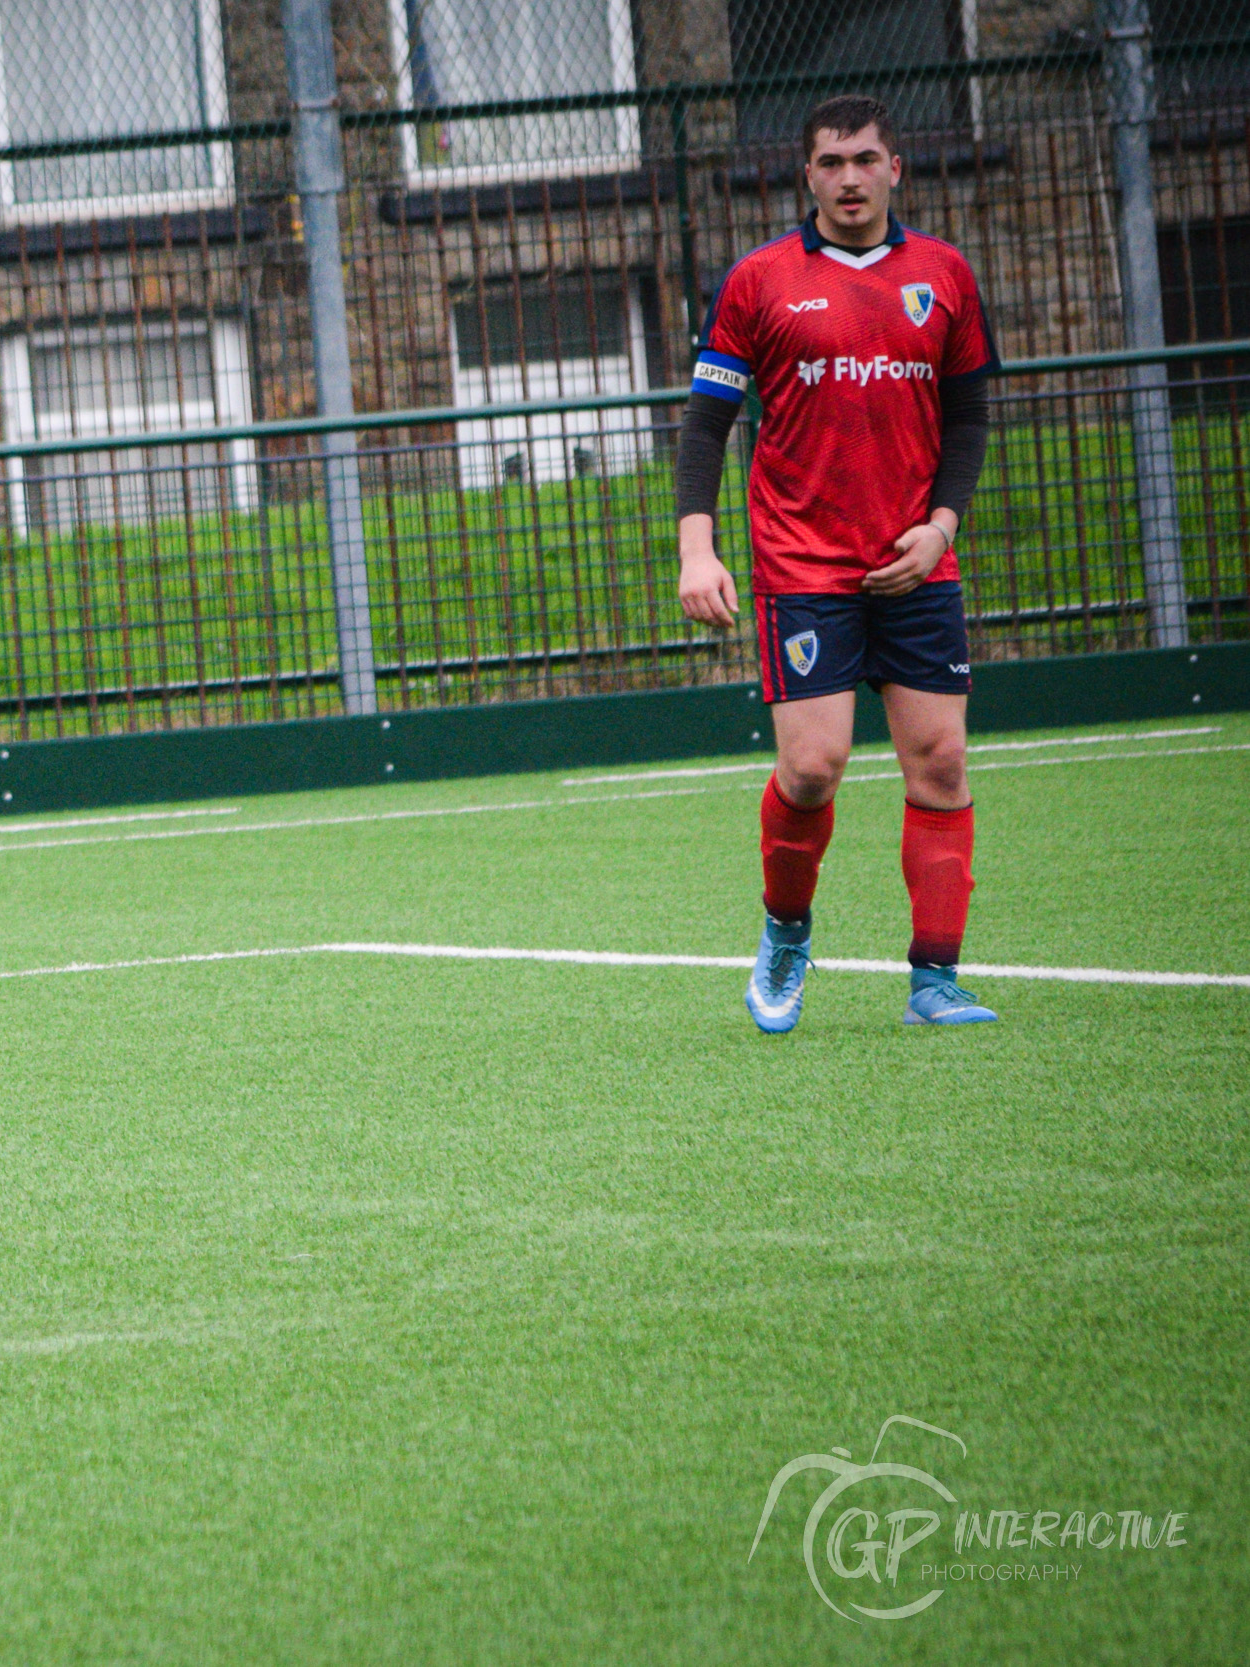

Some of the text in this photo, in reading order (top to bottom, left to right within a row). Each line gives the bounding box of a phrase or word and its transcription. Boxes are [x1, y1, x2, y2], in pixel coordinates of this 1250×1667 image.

[787, 298, 829, 313] VX3
[699, 365, 740, 386] CAPTAIN
[834, 355, 933, 387] FlyForm
